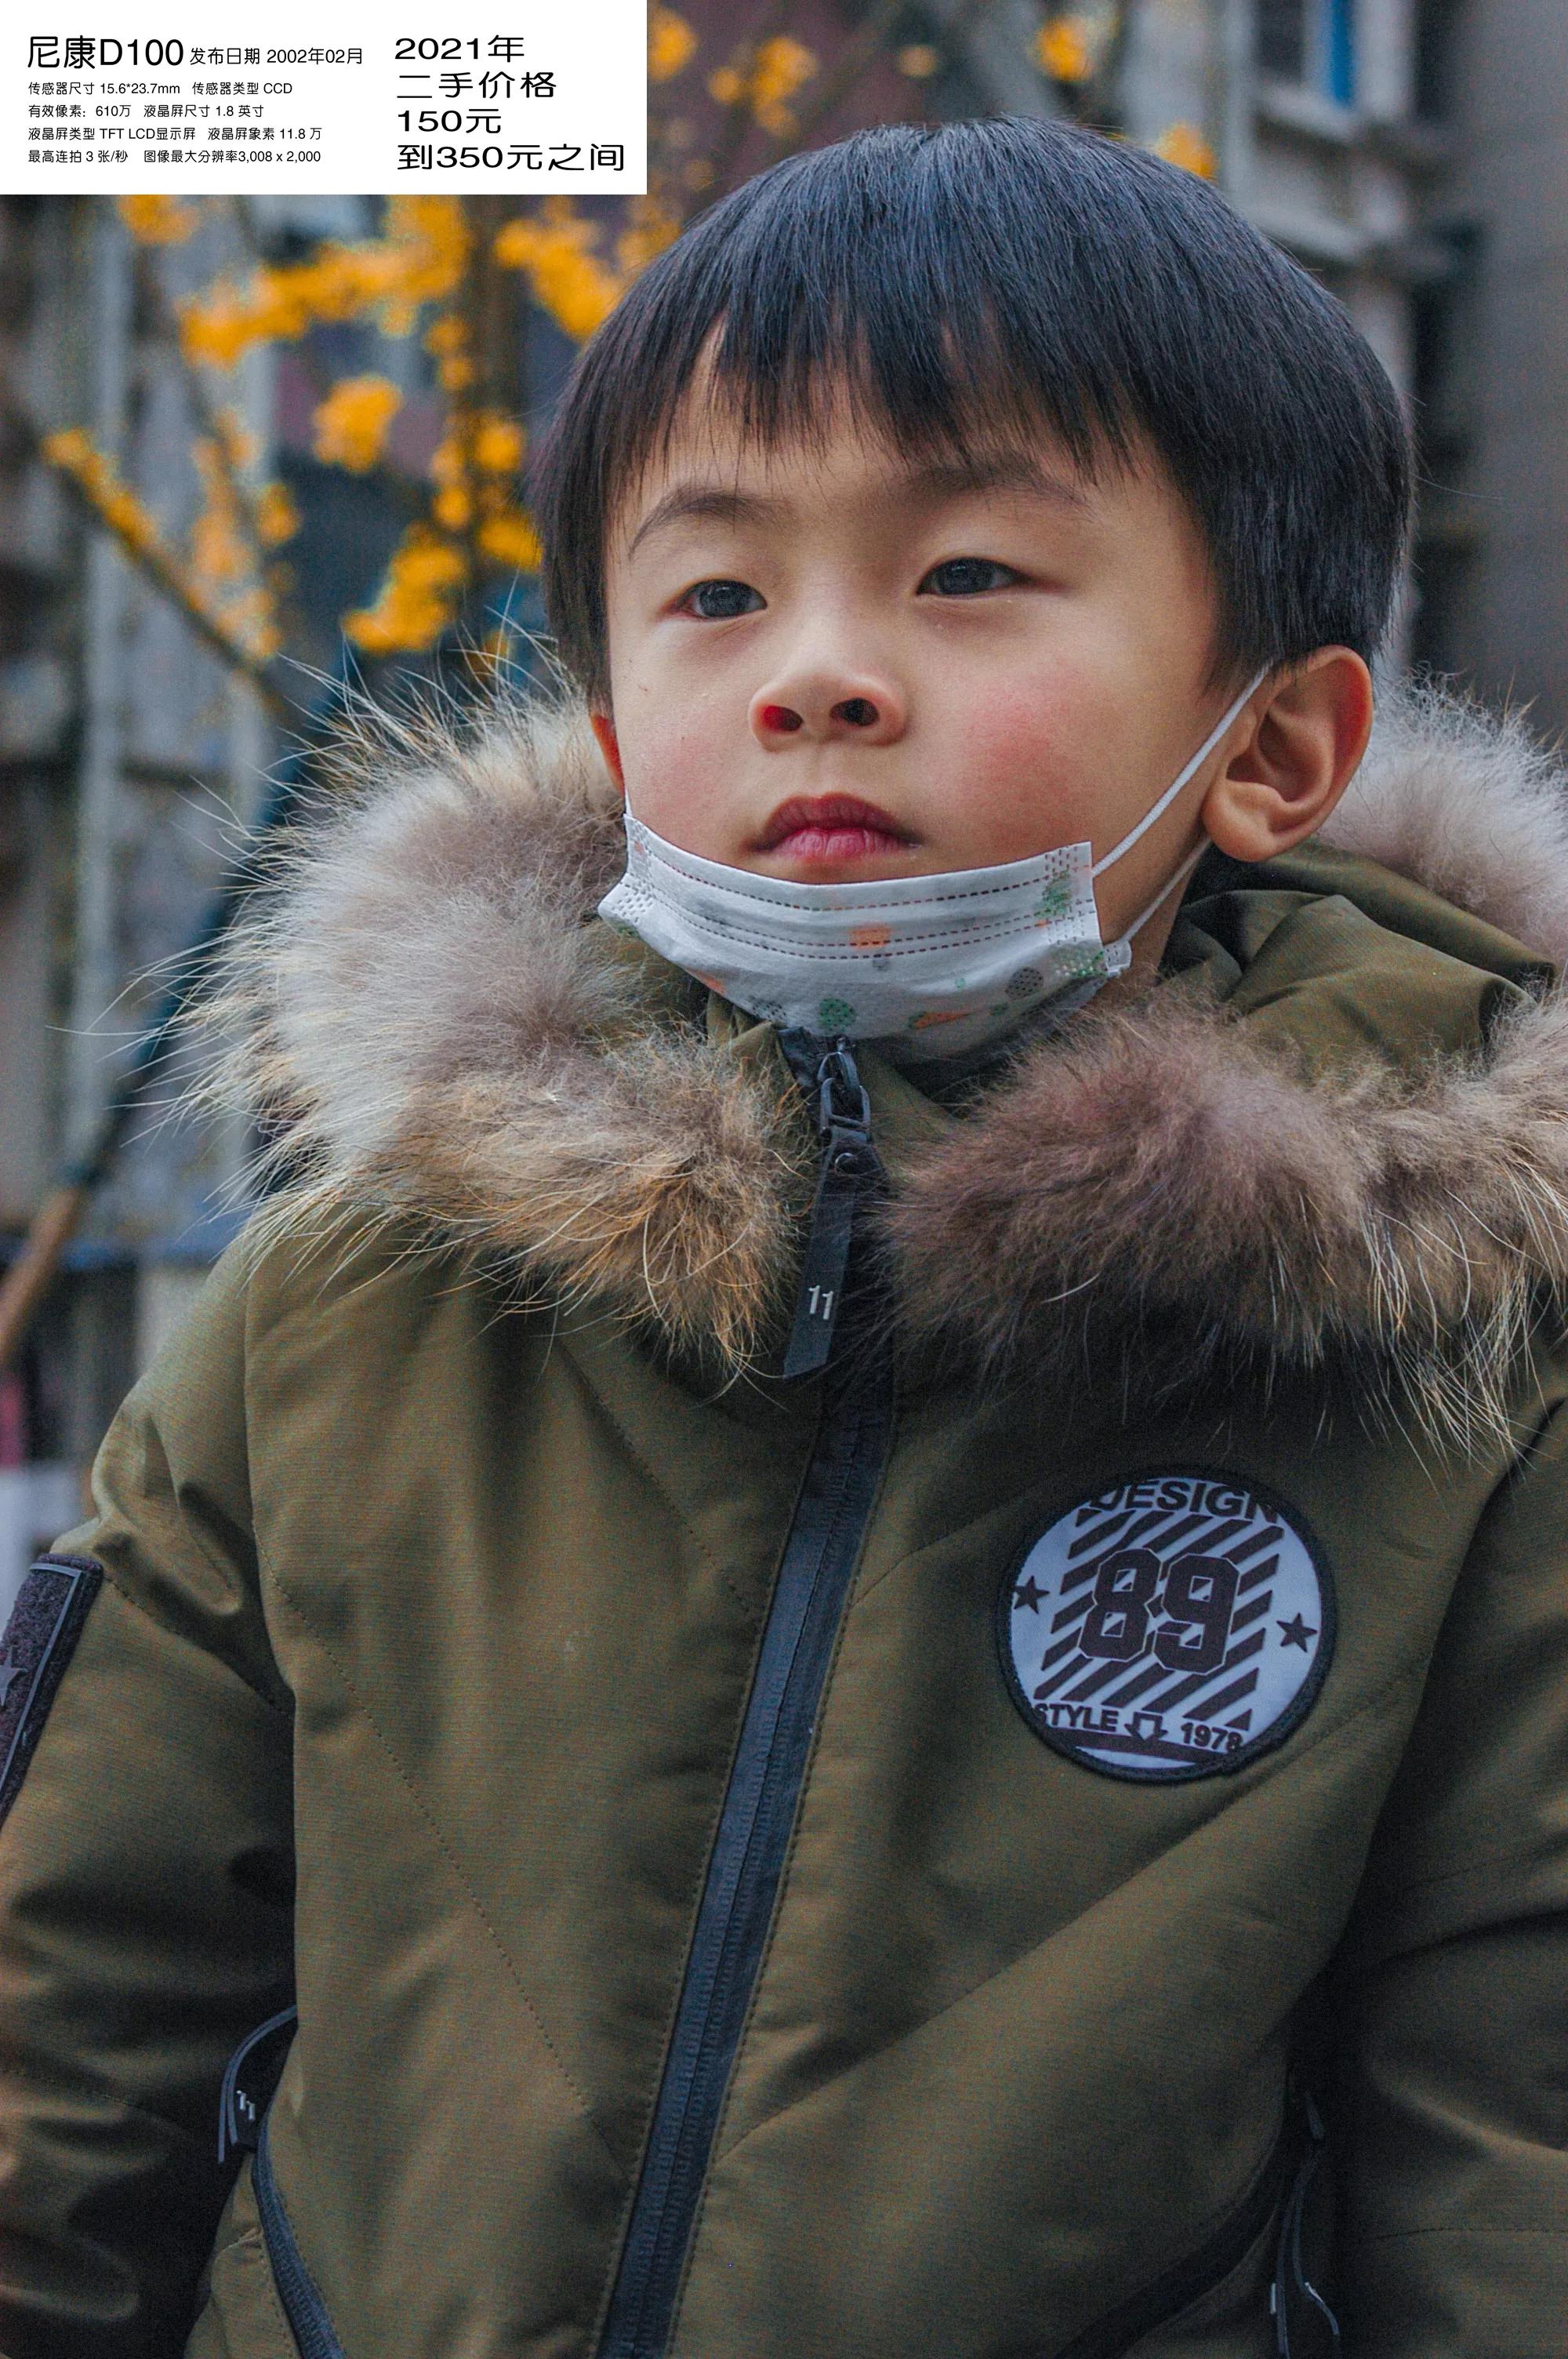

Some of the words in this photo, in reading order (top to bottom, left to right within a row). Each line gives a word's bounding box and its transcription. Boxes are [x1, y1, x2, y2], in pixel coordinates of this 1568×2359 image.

[808, 1285, 833, 1320] 11
[1077, 1548, 1241, 1675] 89
[1033, 1703, 1119, 1732] STYLE
[1180, 1721, 1243, 1753] 1978
